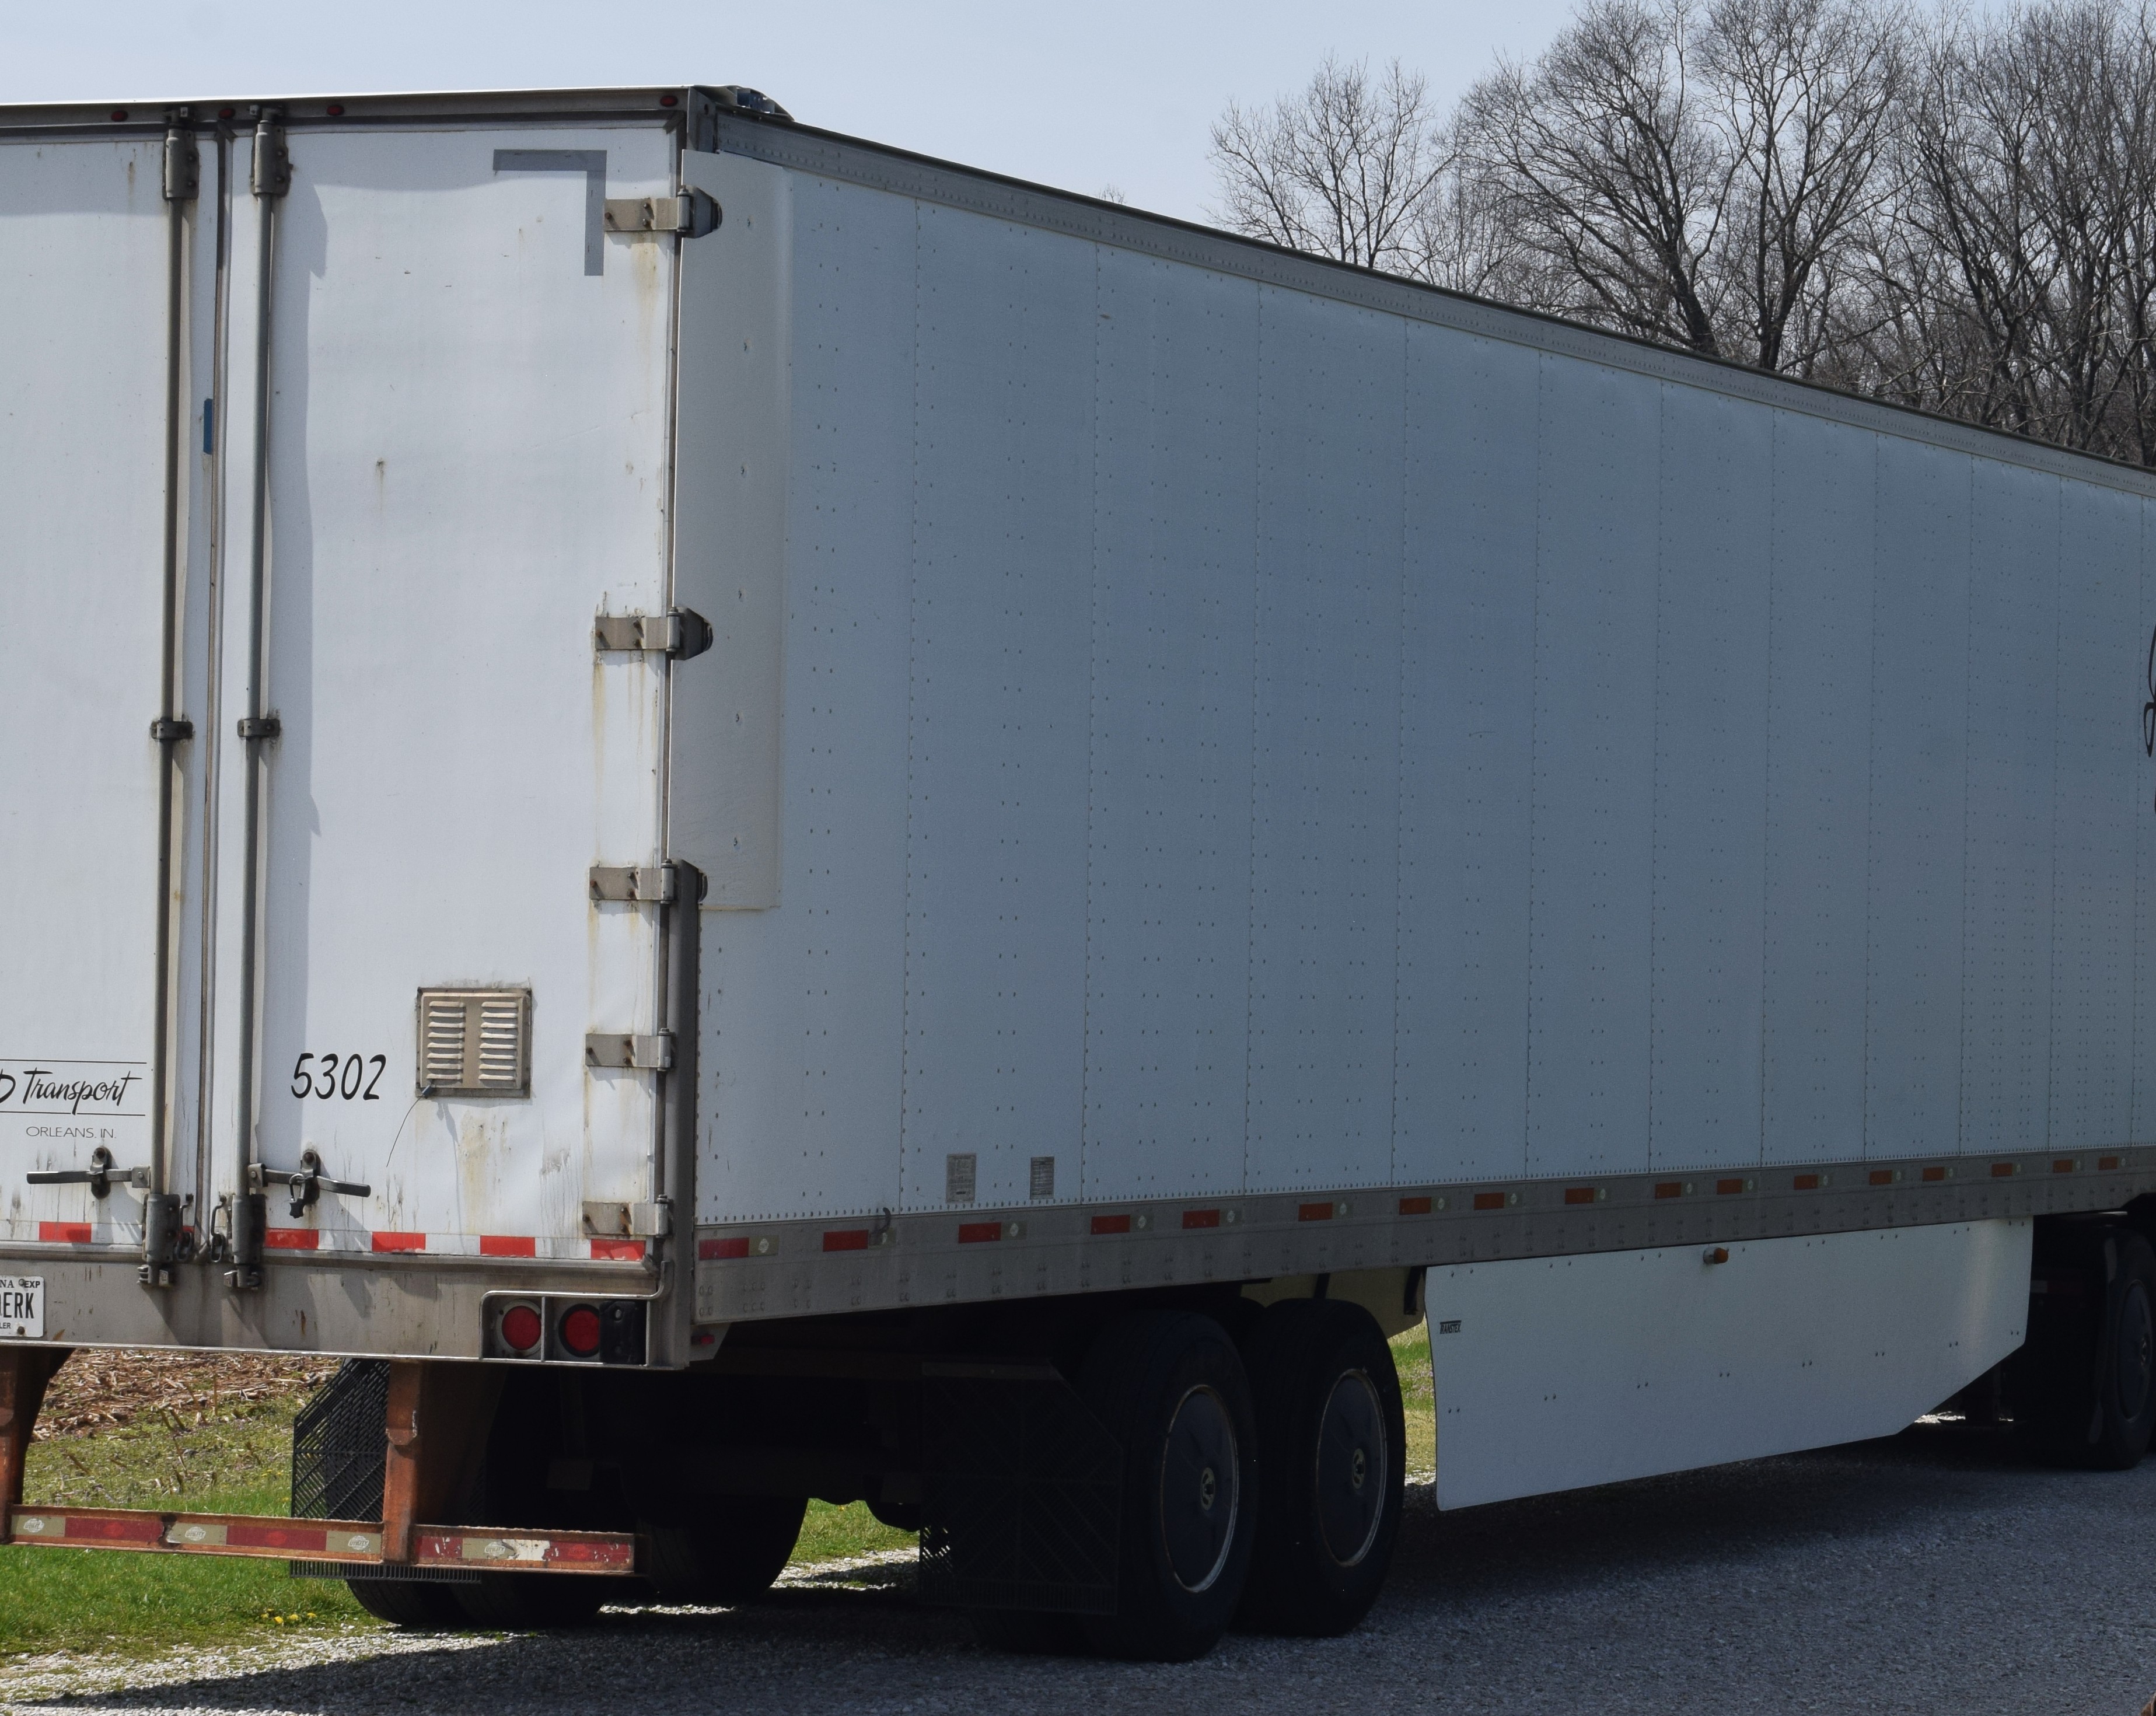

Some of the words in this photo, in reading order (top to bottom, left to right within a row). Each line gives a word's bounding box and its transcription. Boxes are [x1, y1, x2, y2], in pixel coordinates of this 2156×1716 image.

[23, 1067, 143, 1115] Transport
[291, 1053, 386, 1100] 5302
[0, 1292, 34, 1319] ERK
